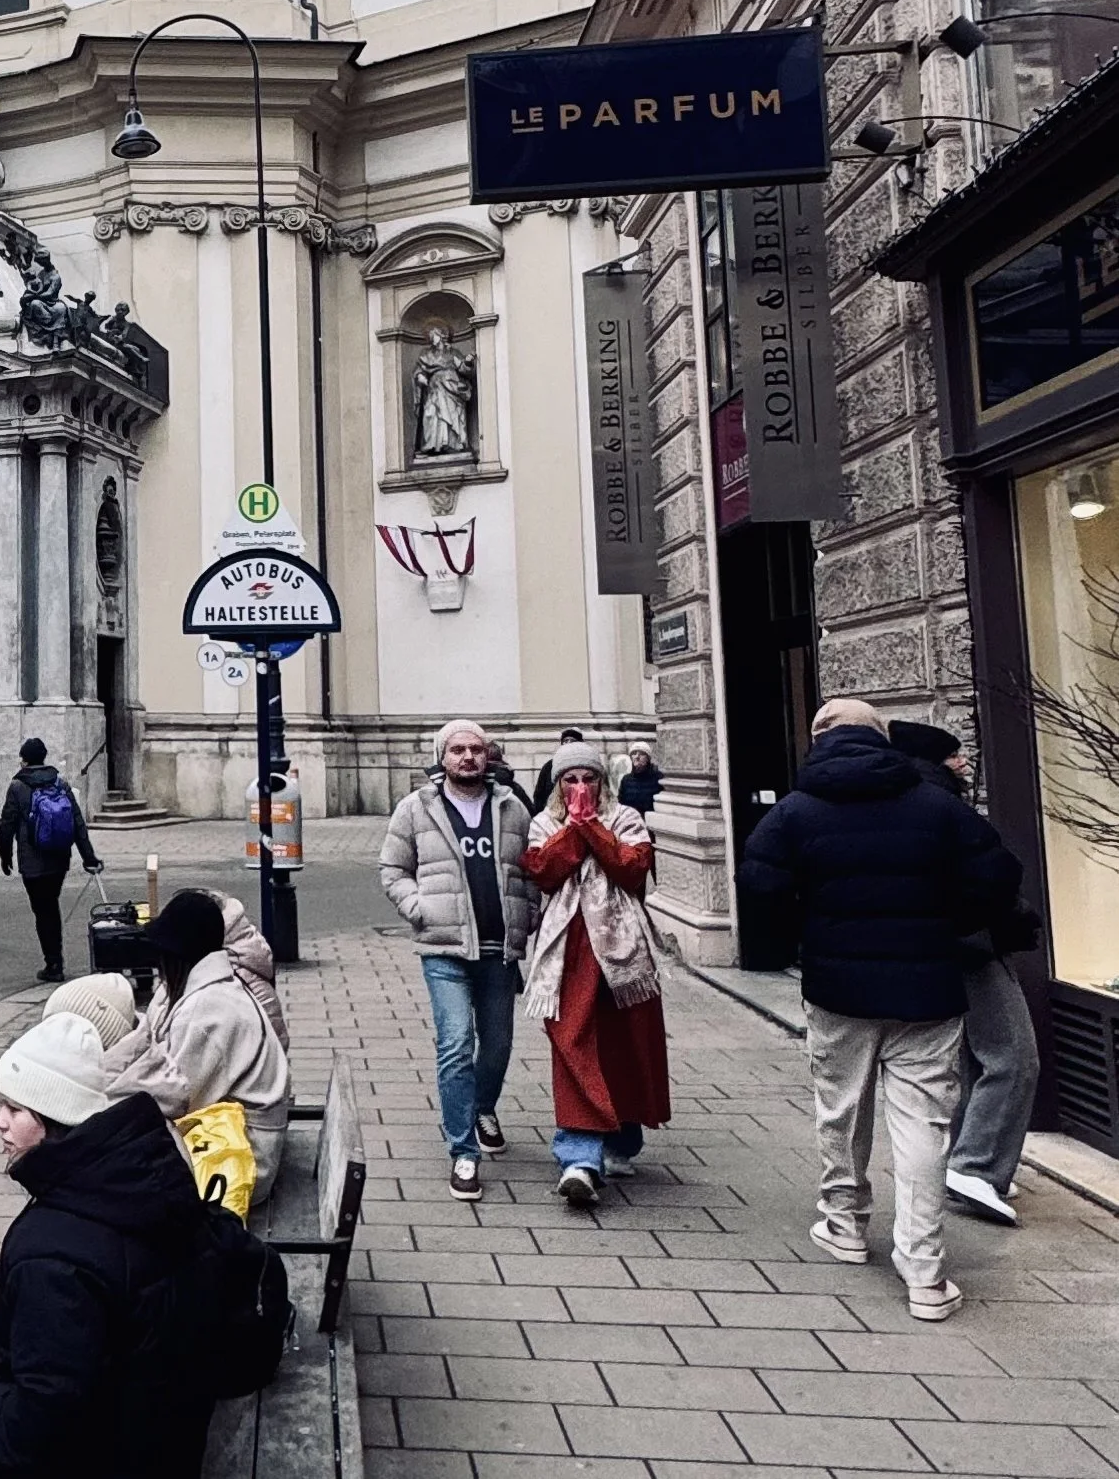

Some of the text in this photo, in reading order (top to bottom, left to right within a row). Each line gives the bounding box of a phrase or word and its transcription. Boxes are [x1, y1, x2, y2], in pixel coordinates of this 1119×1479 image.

[510, 89, 782, 130] LE PARFUM
[795, 224, 818, 328] SILBER
[757, 288, 785, 310] &
[761, 323, 794, 445] ROBBE
[598, 320, 628, 544] ROBBE & BERKING
[629, 394, 643, 466] SILBER
[249, 491, 269, 515] H
[220, 562, 304, 590] AUTOBUS
[205, 605, 319, 621] HALTESTELLE
[204, 652, 219, 663] 1A
[228, 667, 243, 678] 2A
